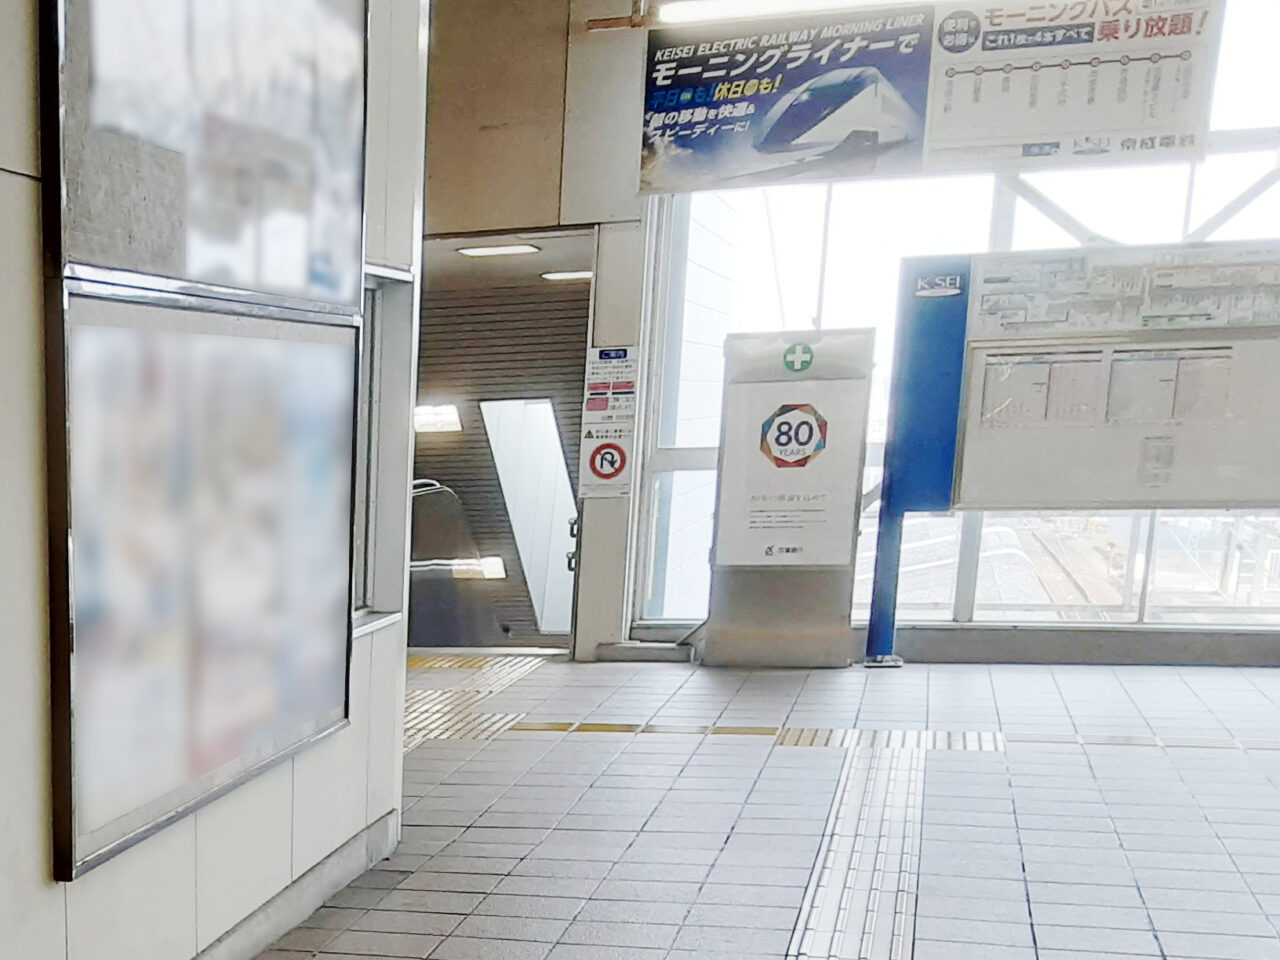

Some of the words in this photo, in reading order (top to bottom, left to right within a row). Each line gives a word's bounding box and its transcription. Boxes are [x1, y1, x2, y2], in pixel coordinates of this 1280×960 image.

[655, 45, 695, 61] KEISEI
[697, 36, 758, 56] ELECTRIC
[760, 28, 818, 47] RAILWAY
[820, 19, 883, 38] MORNING
[885, 13, 925, 30] LINER
[652, 32, 920, 86] モーニングライナーで
[775, 421, 813, 446] 80
[778, 448, 807, 457] YEARS
